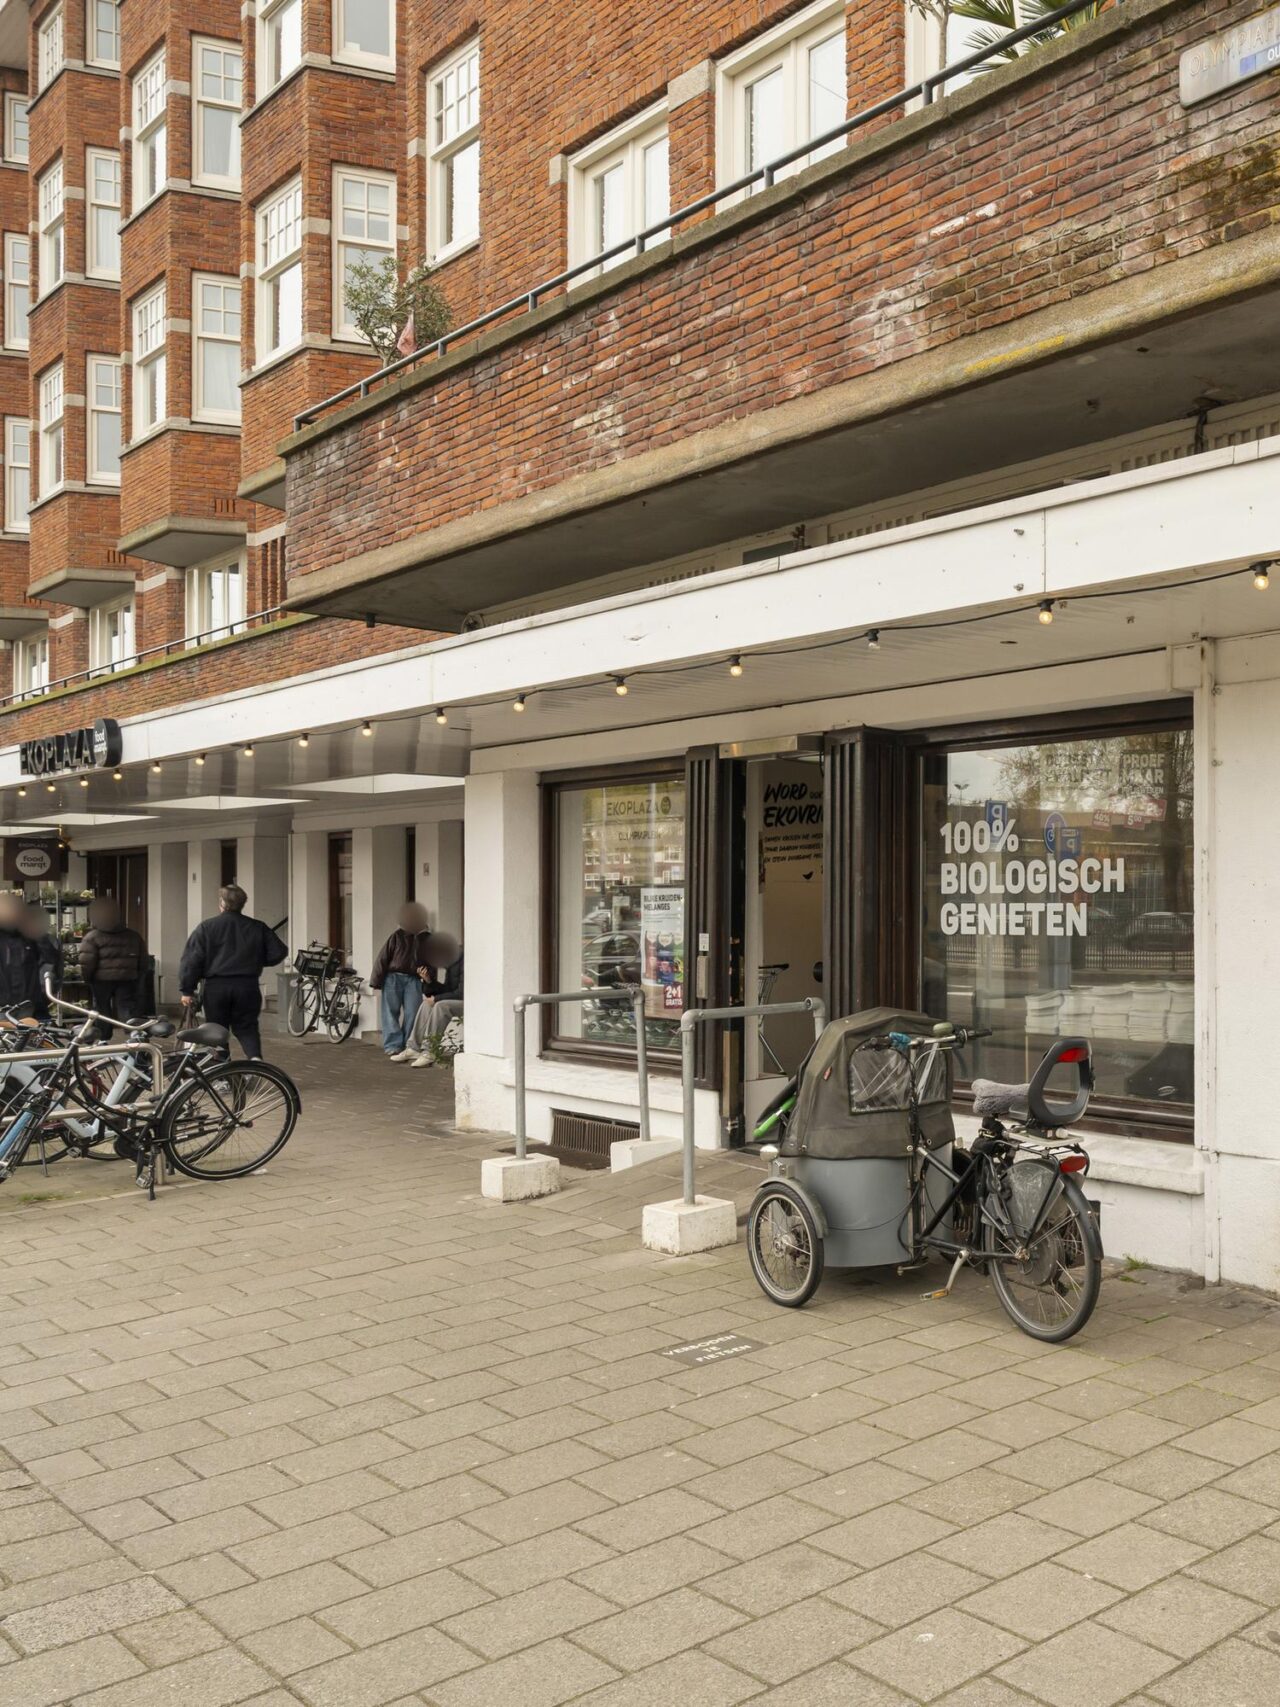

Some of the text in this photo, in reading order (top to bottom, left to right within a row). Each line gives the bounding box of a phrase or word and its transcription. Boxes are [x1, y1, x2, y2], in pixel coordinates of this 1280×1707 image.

[95, 728, 105, 743] food
[20, 727, 92, 776] EKOPLAZA
[1124, 754, 1165, 768] PROEF
[1122, 769, 1164, 784] MAAR
[763, 782, 808, 803] WORD
[606, 800, 660, 816] EKOPLAZA
[763, 804, 824, 828] EKOVRI
[940, 819, 1020, 854] 100%
[20, 861, 47, 870] marqt
[940, 858, 1125, 895] BIOLOGISCH
[940, 902, 1088, 937] GENIETEN
[665, 985, 682, 999] 2+1
[665, 998, 683, 1007] GRATIS
[662, 1334, 738, 1356] VERBODEN
[695, 1344, 753, 1363] FIETSEN
